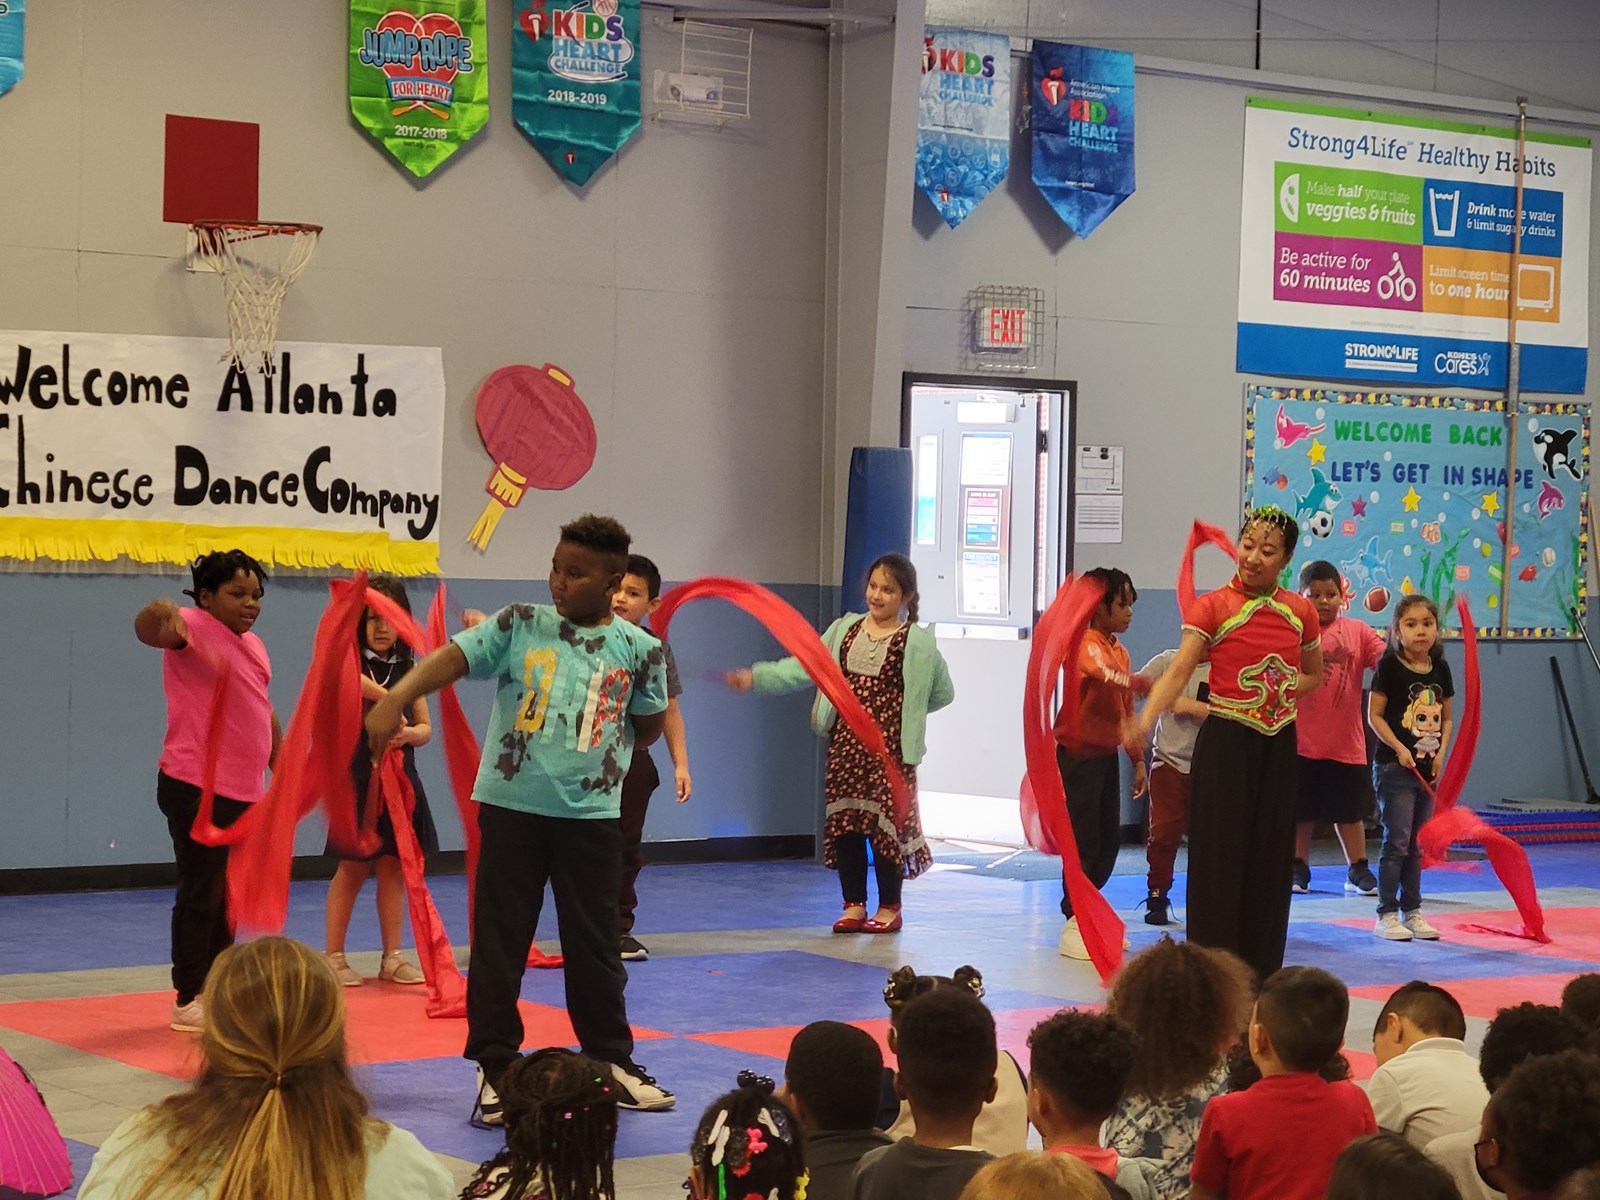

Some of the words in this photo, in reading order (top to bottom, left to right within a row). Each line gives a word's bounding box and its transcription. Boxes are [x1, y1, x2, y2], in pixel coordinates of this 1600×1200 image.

[553, 11, 623, 41] KIDS
[360, 29, 419, 67] JUMP
[421, 32, 474, 71] ROPE
[554, 39, 622, 62] HEART
[554, 59, 621, 73] CHALLENGE
[940, 48, 995, 77] KIDS
[393, 82, 413, 96] FOR
[417, 83, 450, 101] HEART
[940, 72, 994, 95] HEART
[548, 90, 607, 105] 2018-2019
[395, 125, 447, 140] 2017-2018
[1068, 120, 1118, 141] HEART
[1068, 138, 1118, 152] CHALLENGE
[1417, 143, 1490, 174] Healthy
[1306, 181, 1336, 196] Make
[1337, 184, 1363, 198] half
[1364, 188, 1387, 201] your
[1306, 202, 1367, 222] veggies
[1368, 204, 1379, 220] &
[1381, 205, 1416, 225] fruits
[1467, 202, 1496, 216] Drink
[1498, 208, 1526, 220] moe
[1529, 210, 1556, 223] water
[1466, 218, 1473, 229] &
[1474, 219, 1495, 231] limit
[1496, 225, 1527, 237] sugay
[1528, 225, 1556, 237] drinks
[1280, 247, 1298, 264] Be
[1301, 252, 1347, 269] active
[1350, 253, 1371, 270] for
[1280, 268, 1300, 287] 60
[1303, 272, 1371, 293] minutes
[1429, 264, 1457, 277] Limit
[1458, 269, 1488, 280] screen
[1490, 271, 1511, 282] time
[1429, 281, 1445, 296] to
[1447, 285, 1472, 298] one
[1475, 283, 1511, 300] hour
[990, 308, 1025, 343] EXIT
[1434, 353, 1477, 375] Cares
[0, 344, 190, 409] Welcome
[216, 351, 397, 417] Atlanta
[1334, 420, 1432, 444] WELCOME
[1449, 423, 1503, 447] BACK
[1331, 460, 1381, 483] LET'S
[1393, 463, 1430, 484] GET
[1444, 465, 1464, 485] IN
[174, 445, 299, 507] Dance
[303, 446, 439, 540] Company
[513, 644, 631, 753] DRIP
